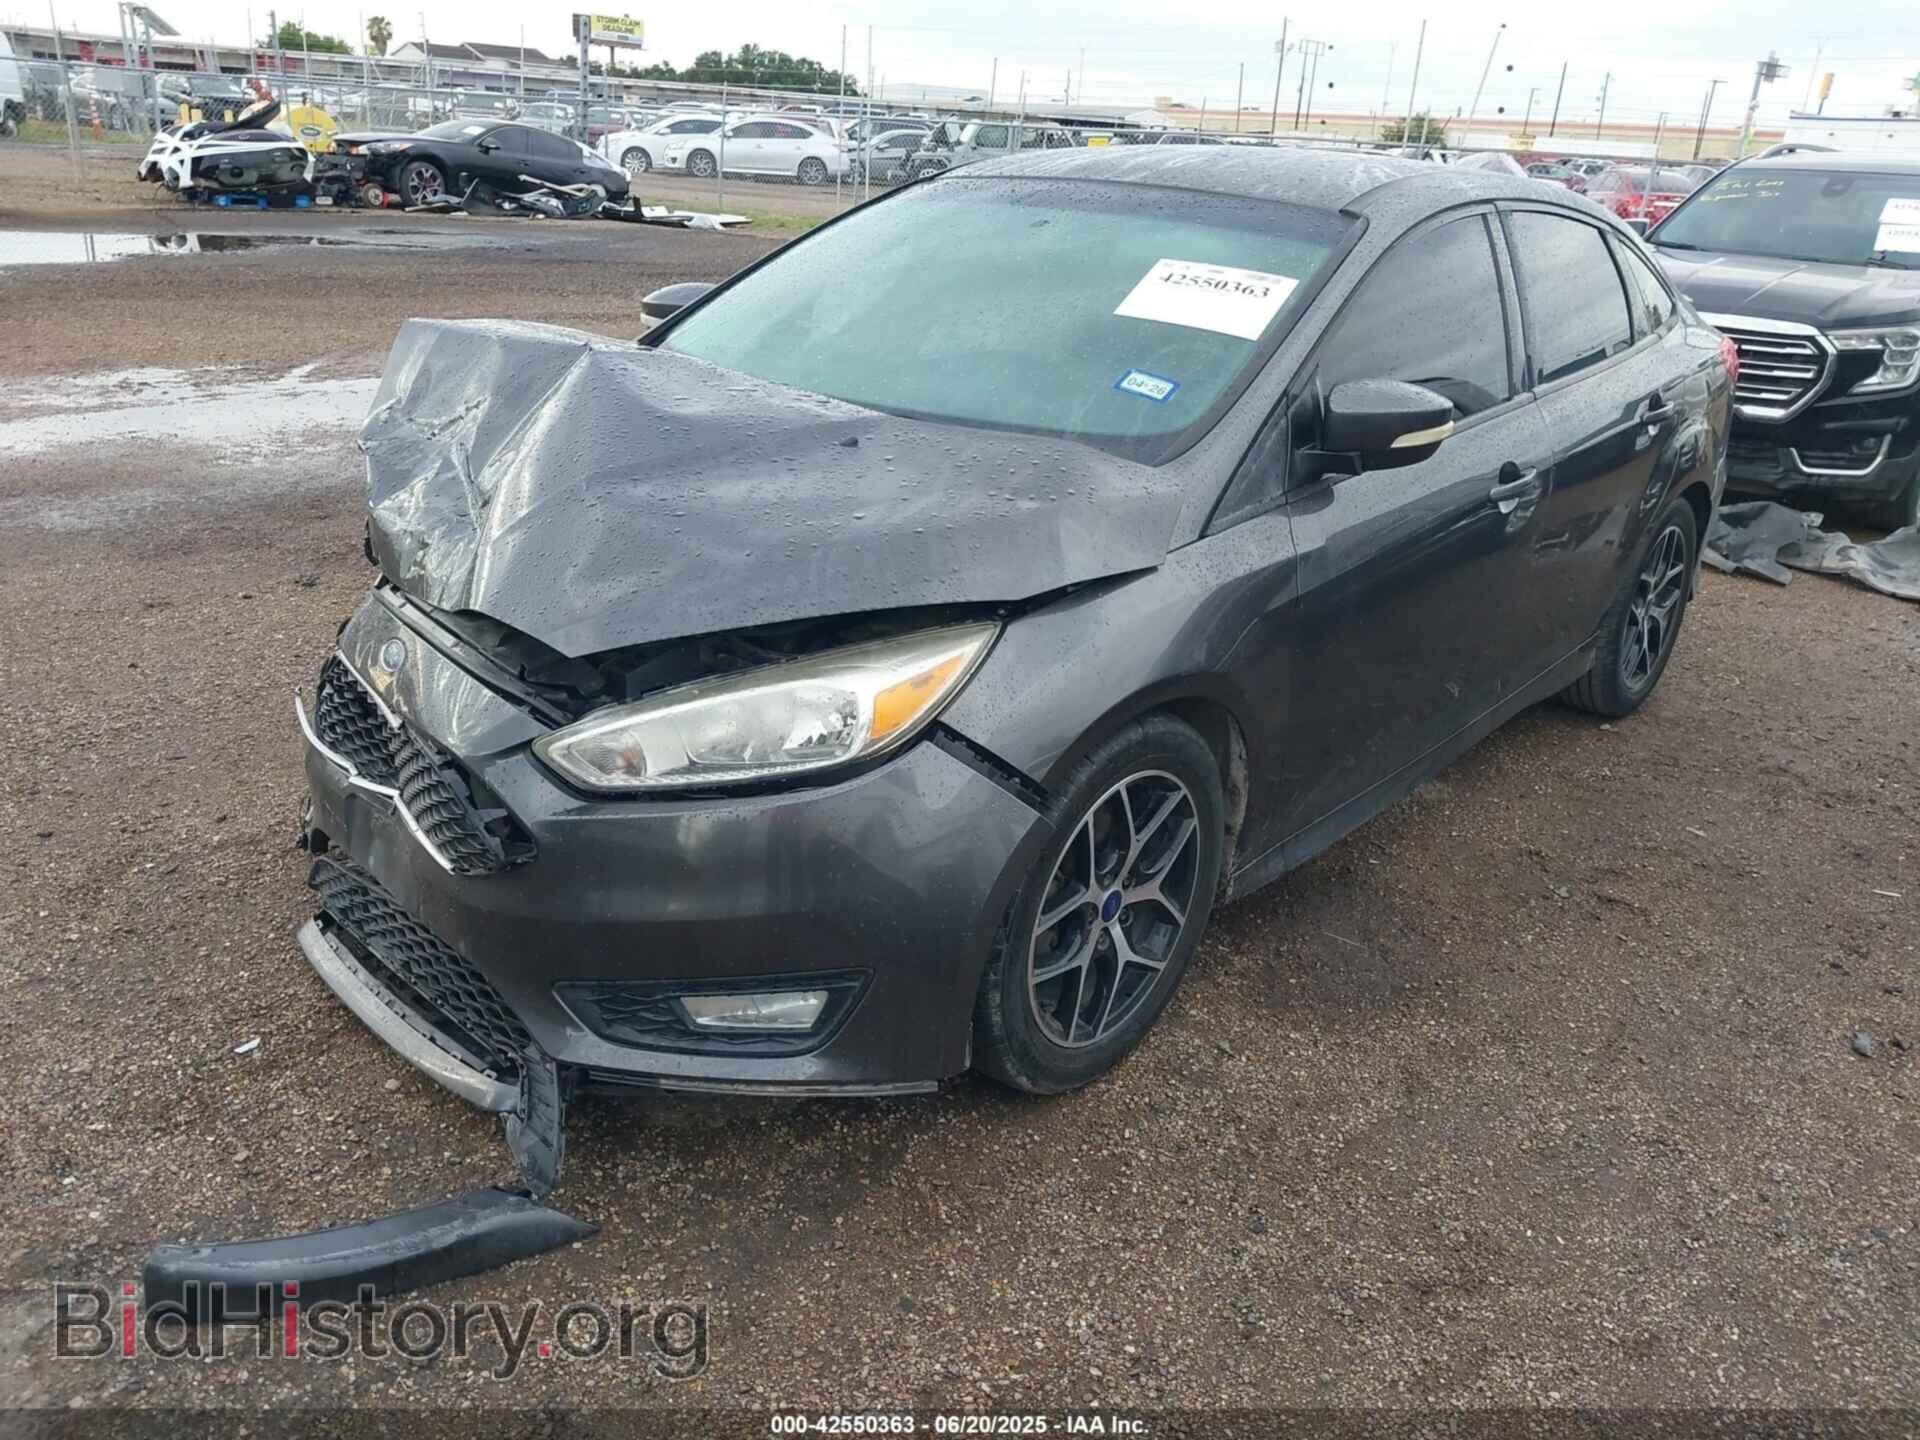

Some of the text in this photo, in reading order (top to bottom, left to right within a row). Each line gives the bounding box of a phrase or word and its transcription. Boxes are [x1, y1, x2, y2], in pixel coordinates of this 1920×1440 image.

[596, 15, 640, 26] STORM CLAIM
[602, 24, 634, 33] DEADLINE
[1160, 272, 1271, 298] 42550363
